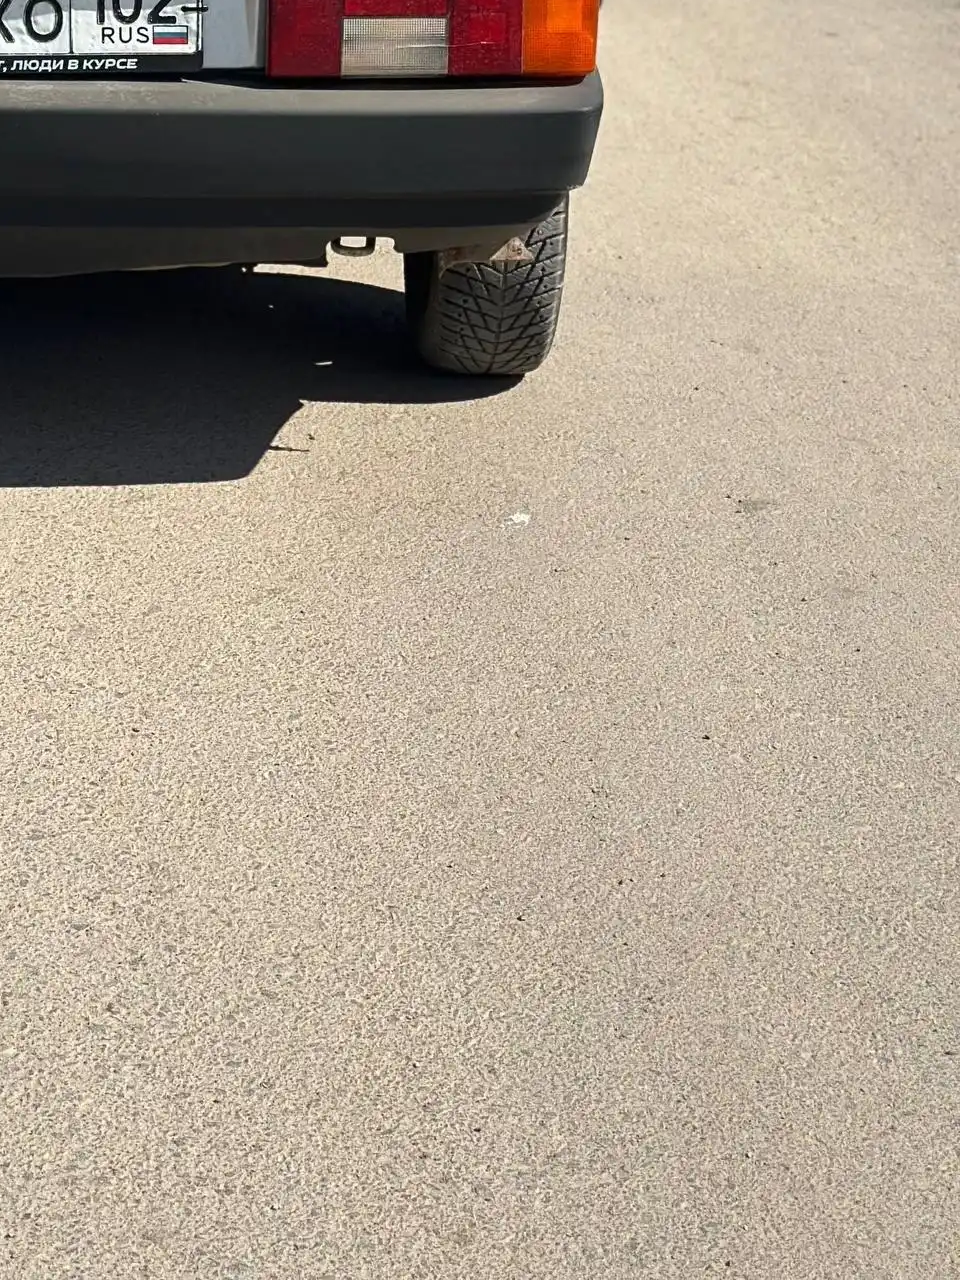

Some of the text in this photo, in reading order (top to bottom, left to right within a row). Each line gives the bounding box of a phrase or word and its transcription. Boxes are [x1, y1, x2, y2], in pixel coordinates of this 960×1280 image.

[101, 26, 150, 45] RUS
[10, 59, 64, 73] ЛЮДИ
[67, 59, 79, 70] В
[82, 58, 139, 70] КУРСЕ
